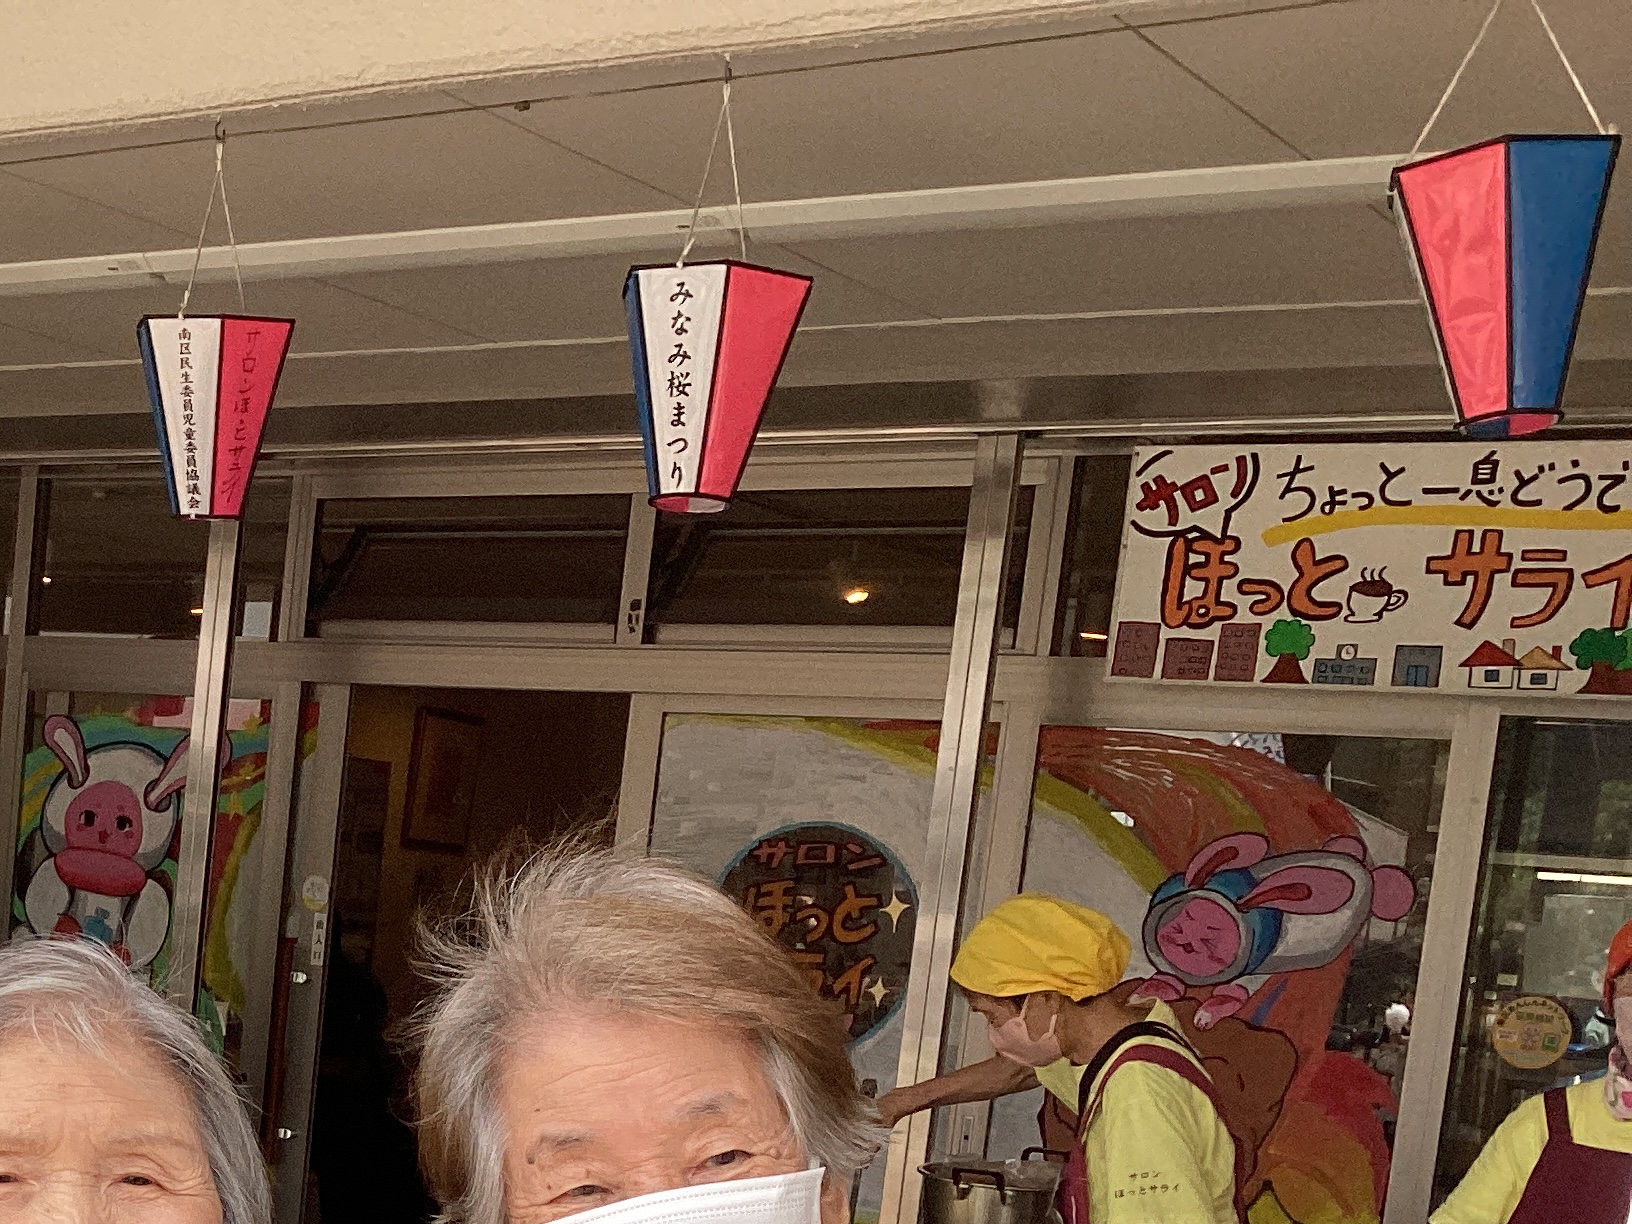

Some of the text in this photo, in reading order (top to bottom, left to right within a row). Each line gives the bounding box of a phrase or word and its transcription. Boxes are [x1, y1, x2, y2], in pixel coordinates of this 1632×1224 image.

[178, 327, 201, 509] 南区民生委員児童委員協議会
[666, 281, 693, 488] みなみ桜まつり
[1135, 454, 1248, 527] サロン
[1160, 528, 1632, 631] ほっと サライ
[752, 840, 884, 870] サロン
[744, 879, 882, 943] ほっと
[1114, 1183, 1180, 1198] ほっとサライ
[1128, 1170, 1161, 1180] サロン
